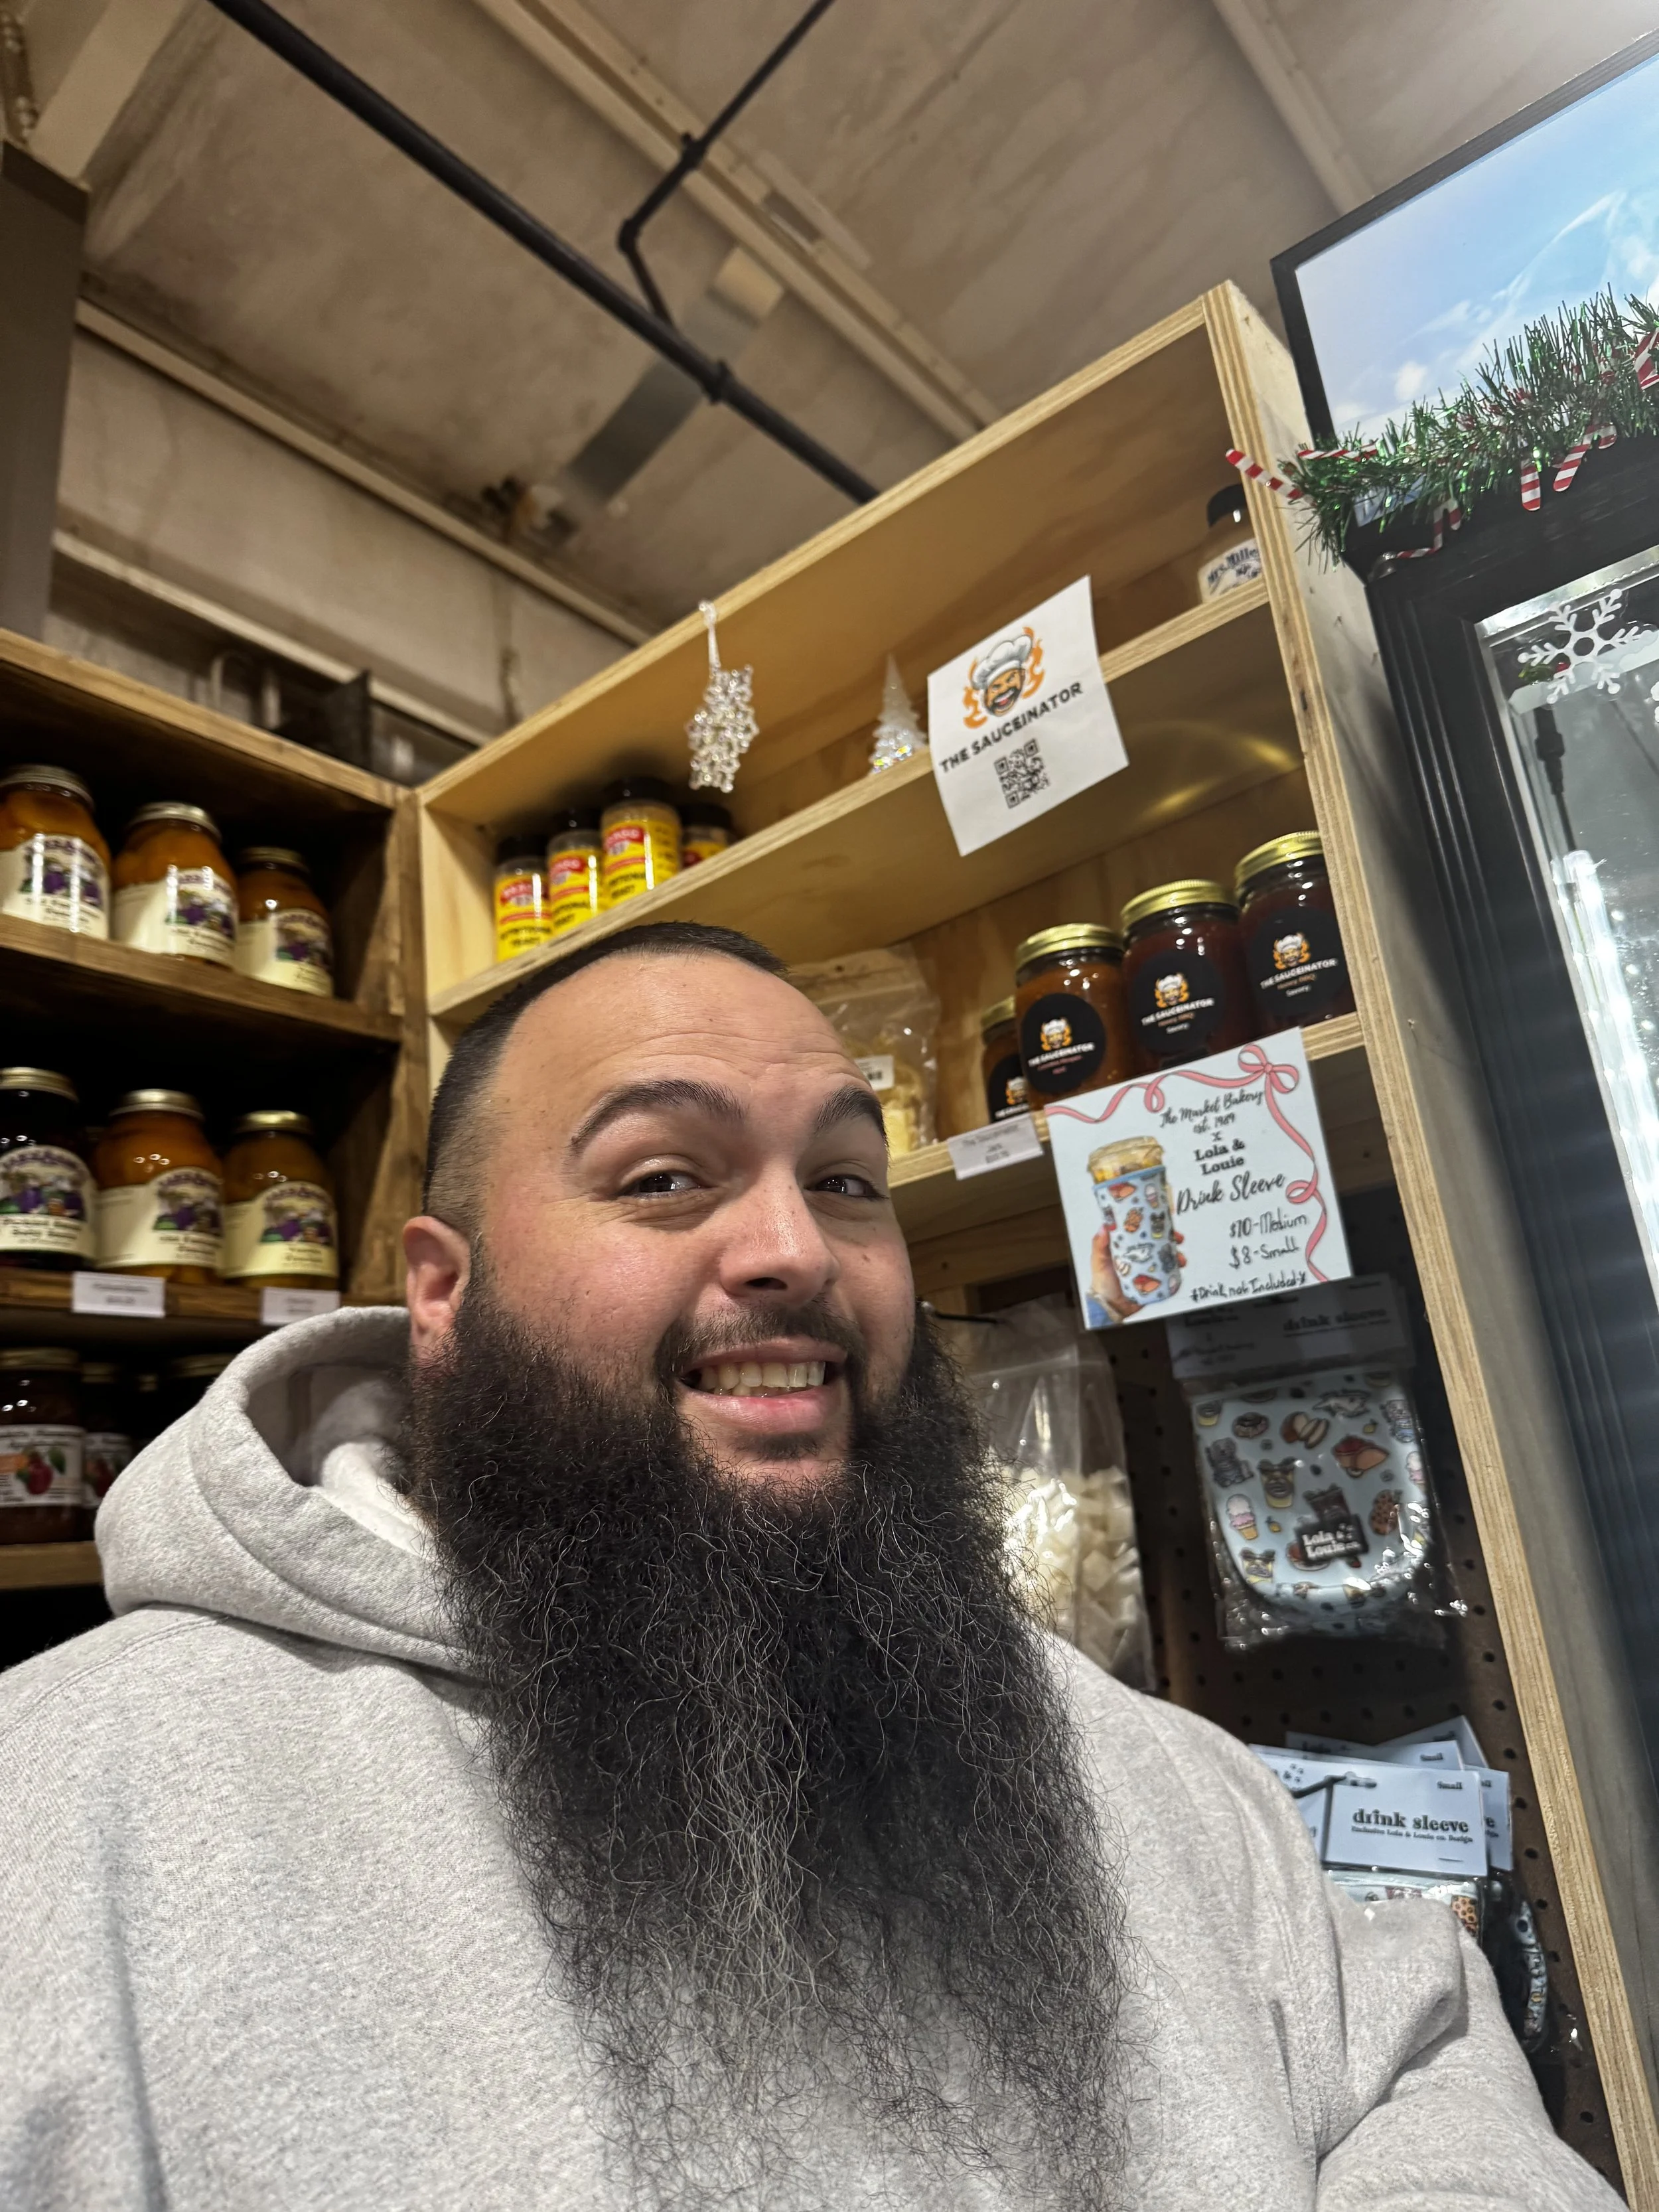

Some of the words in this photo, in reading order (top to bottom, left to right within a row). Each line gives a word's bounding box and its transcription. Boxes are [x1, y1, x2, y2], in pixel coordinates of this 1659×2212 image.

[939, 747, 970, 773] THE
[972, 682, 1082, 755] SAUCEINATOR
[1274, 958, 1339, 983] SAUCEINATOR
[1155, 997, 1215, 1021] SAUCEINATOR
[1160, 1107, 1178, 1128] The
[1179, 1096, 1220, 1121] Market
[1224, 1088, 1265, 1109] Bakery
[1194, 1144, 1228, 1161] Lola
[1232, 1138, 1245, 1151] &
[1200, 1155, 1244, 1175] Louie
[1177, 1179, 1223, 1215] Drink
[1230, 1170, 1285, 1201] Sleeve
[1229, 1280, 1248, 1297] not
[1302, 1530, 1334, 1546] Lola
[1305, 1540, 1345, 1559] Louie
[1437, 1781, 1463, 1790] Small
[1352, 1808, 1406, 1828] drink
[1412, 1814, 1469, 1833] sleeve
